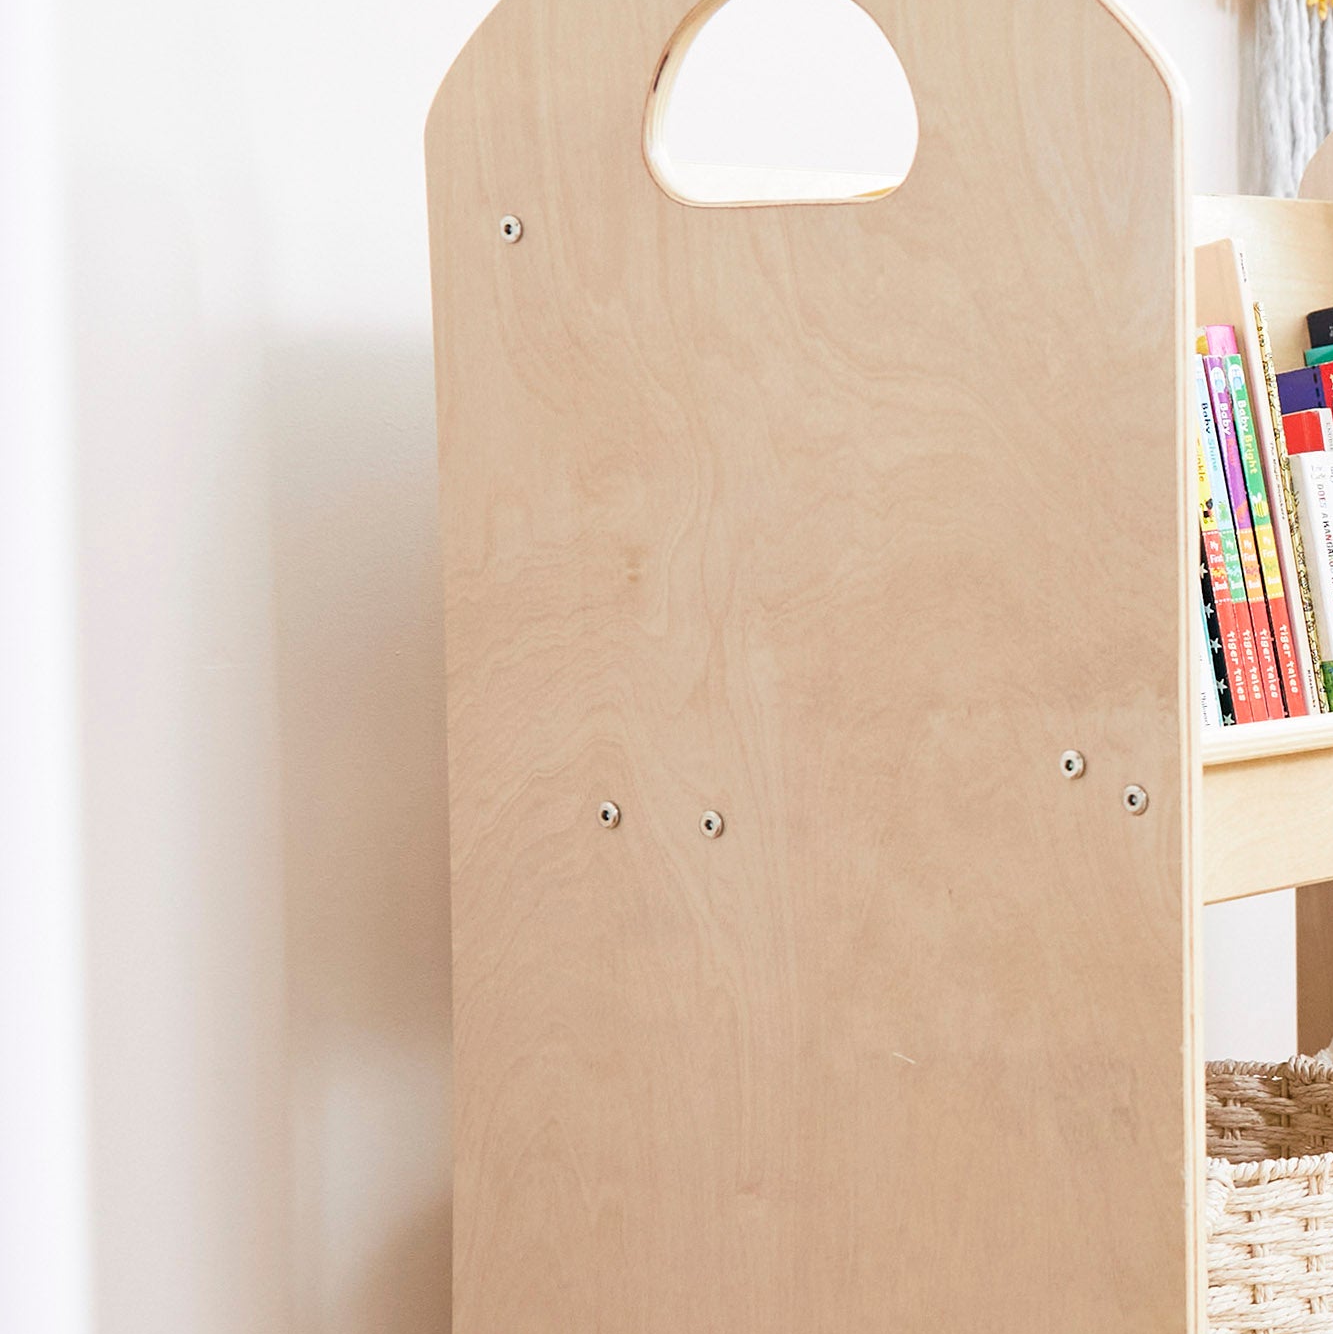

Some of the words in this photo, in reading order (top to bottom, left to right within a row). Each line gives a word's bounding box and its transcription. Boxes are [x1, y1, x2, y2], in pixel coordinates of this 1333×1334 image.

[1201, 403, 1211, 434] Baby
[1220, 402, 1231, 436] Baby
[1237, 400, 1249, 432] Baby
[1245, 435, 1258, 474] Bright
[1226, 631, 1239, 665] tiger
[1234, 668, 1246, 701] tales
[1242, 629, 1254, 663] tiger
[1249, 666, 1261, 699] tales
[1260, 629, 1271, 662] tiger
[1267, 665, 1278, 698] tales
[1279, 624, 1291, 658] tiger
[1286, 660, 1298, 694] tales
